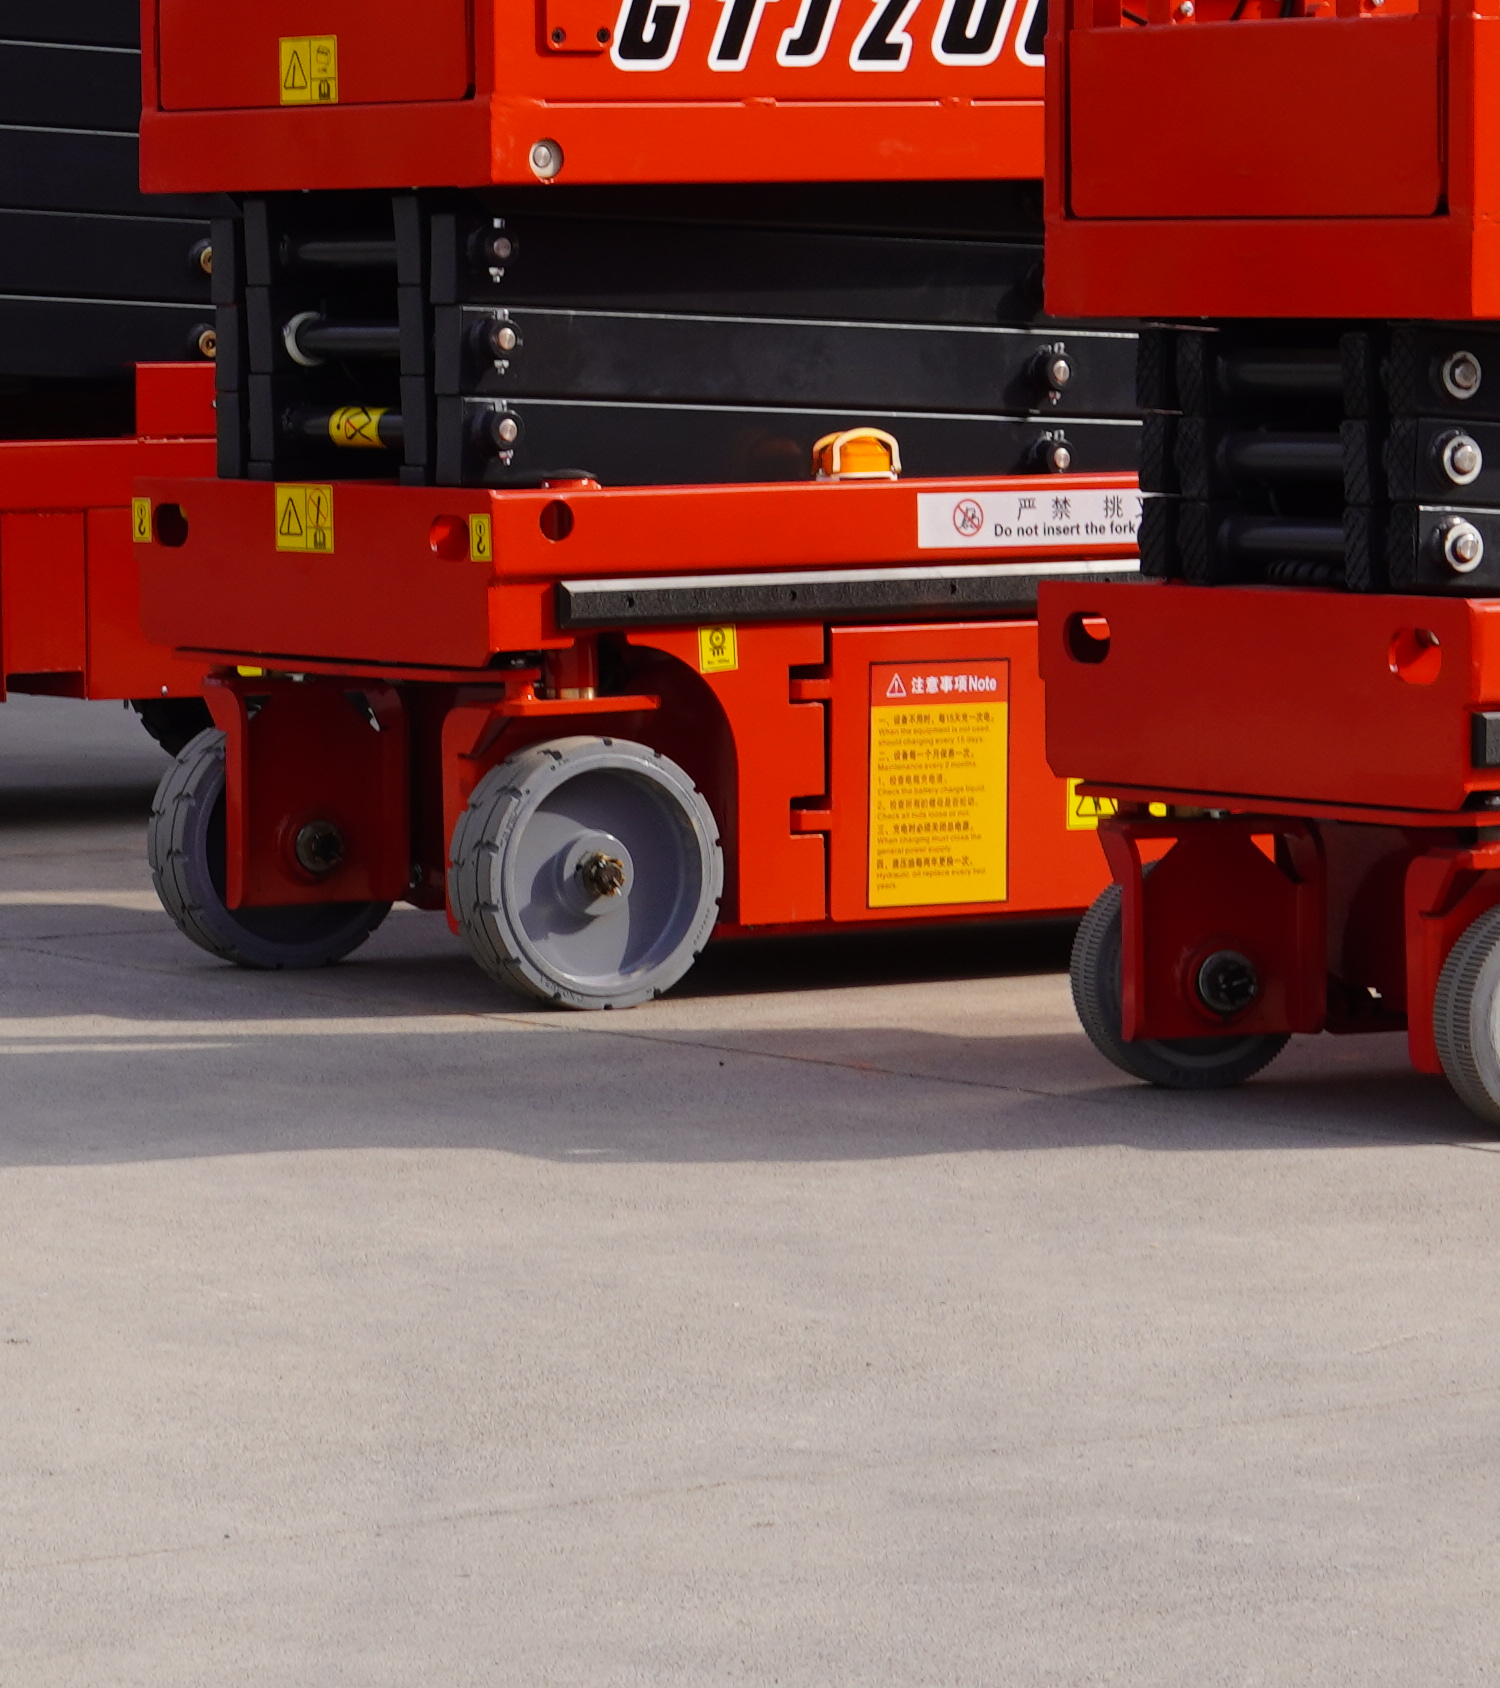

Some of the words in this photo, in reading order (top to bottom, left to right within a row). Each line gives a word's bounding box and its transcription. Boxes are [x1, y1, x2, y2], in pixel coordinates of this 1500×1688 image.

[994, 524, 1012, 538] Do
[1016, 524, 1039, 537] not
[1042, 522, 1080, 537] insert
[1084, 522, 1106, 536] the
[911, 675, 997, 694] 注意事项Note
